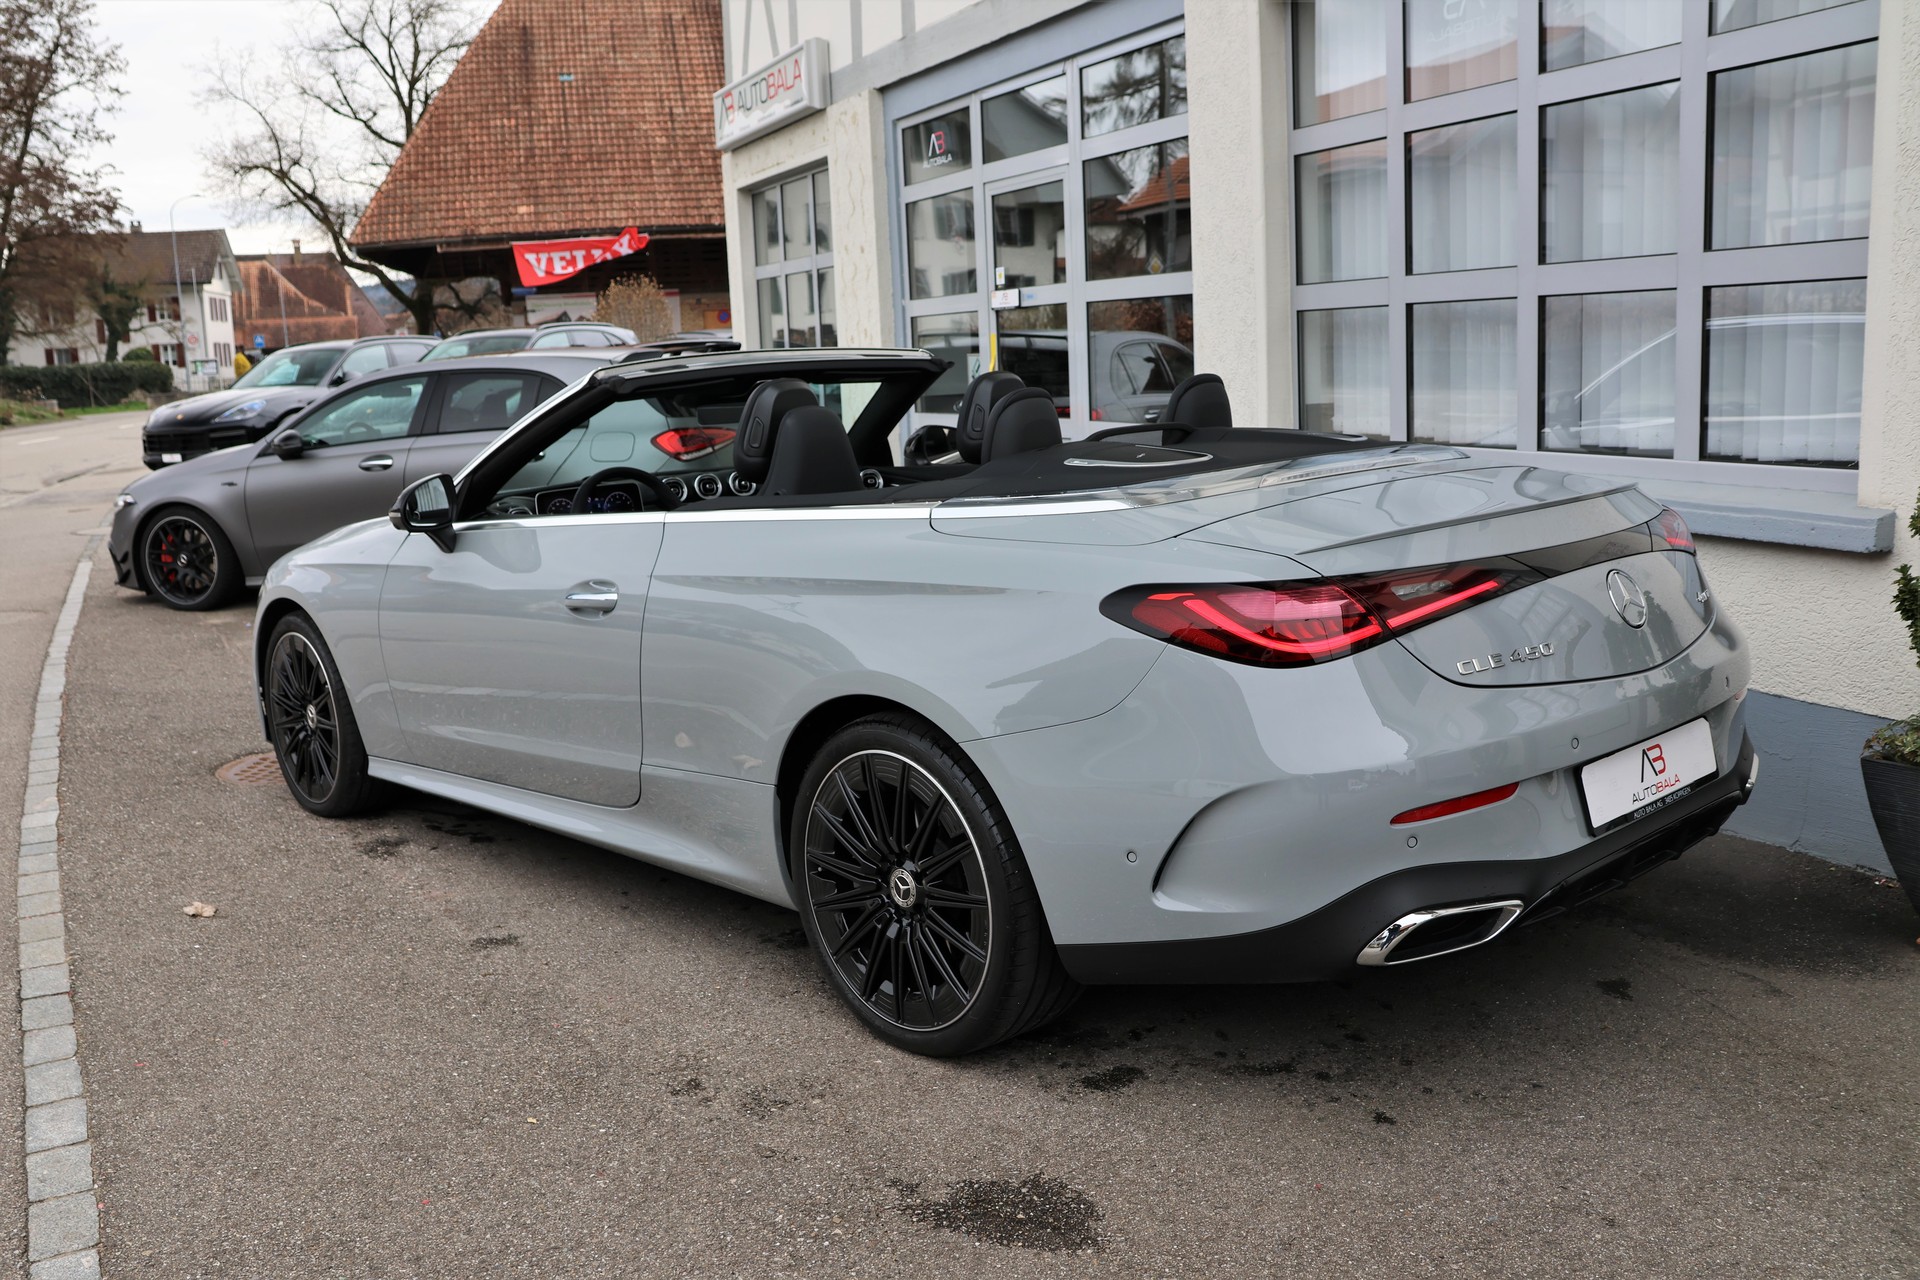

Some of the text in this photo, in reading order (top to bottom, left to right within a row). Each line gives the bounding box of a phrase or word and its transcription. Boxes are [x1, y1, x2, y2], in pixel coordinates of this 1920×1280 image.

[738, 58, 803, 113] AUTOBALA
[1456, 642, 1554, 675] CLE 450
[1641, 743, 1666, 783] AB
[1632, 774, 1681, 805] AUTOBALA
[1633, 808, 1646, 819] AUTO
[1645, 803, 1657, 813] BALA
